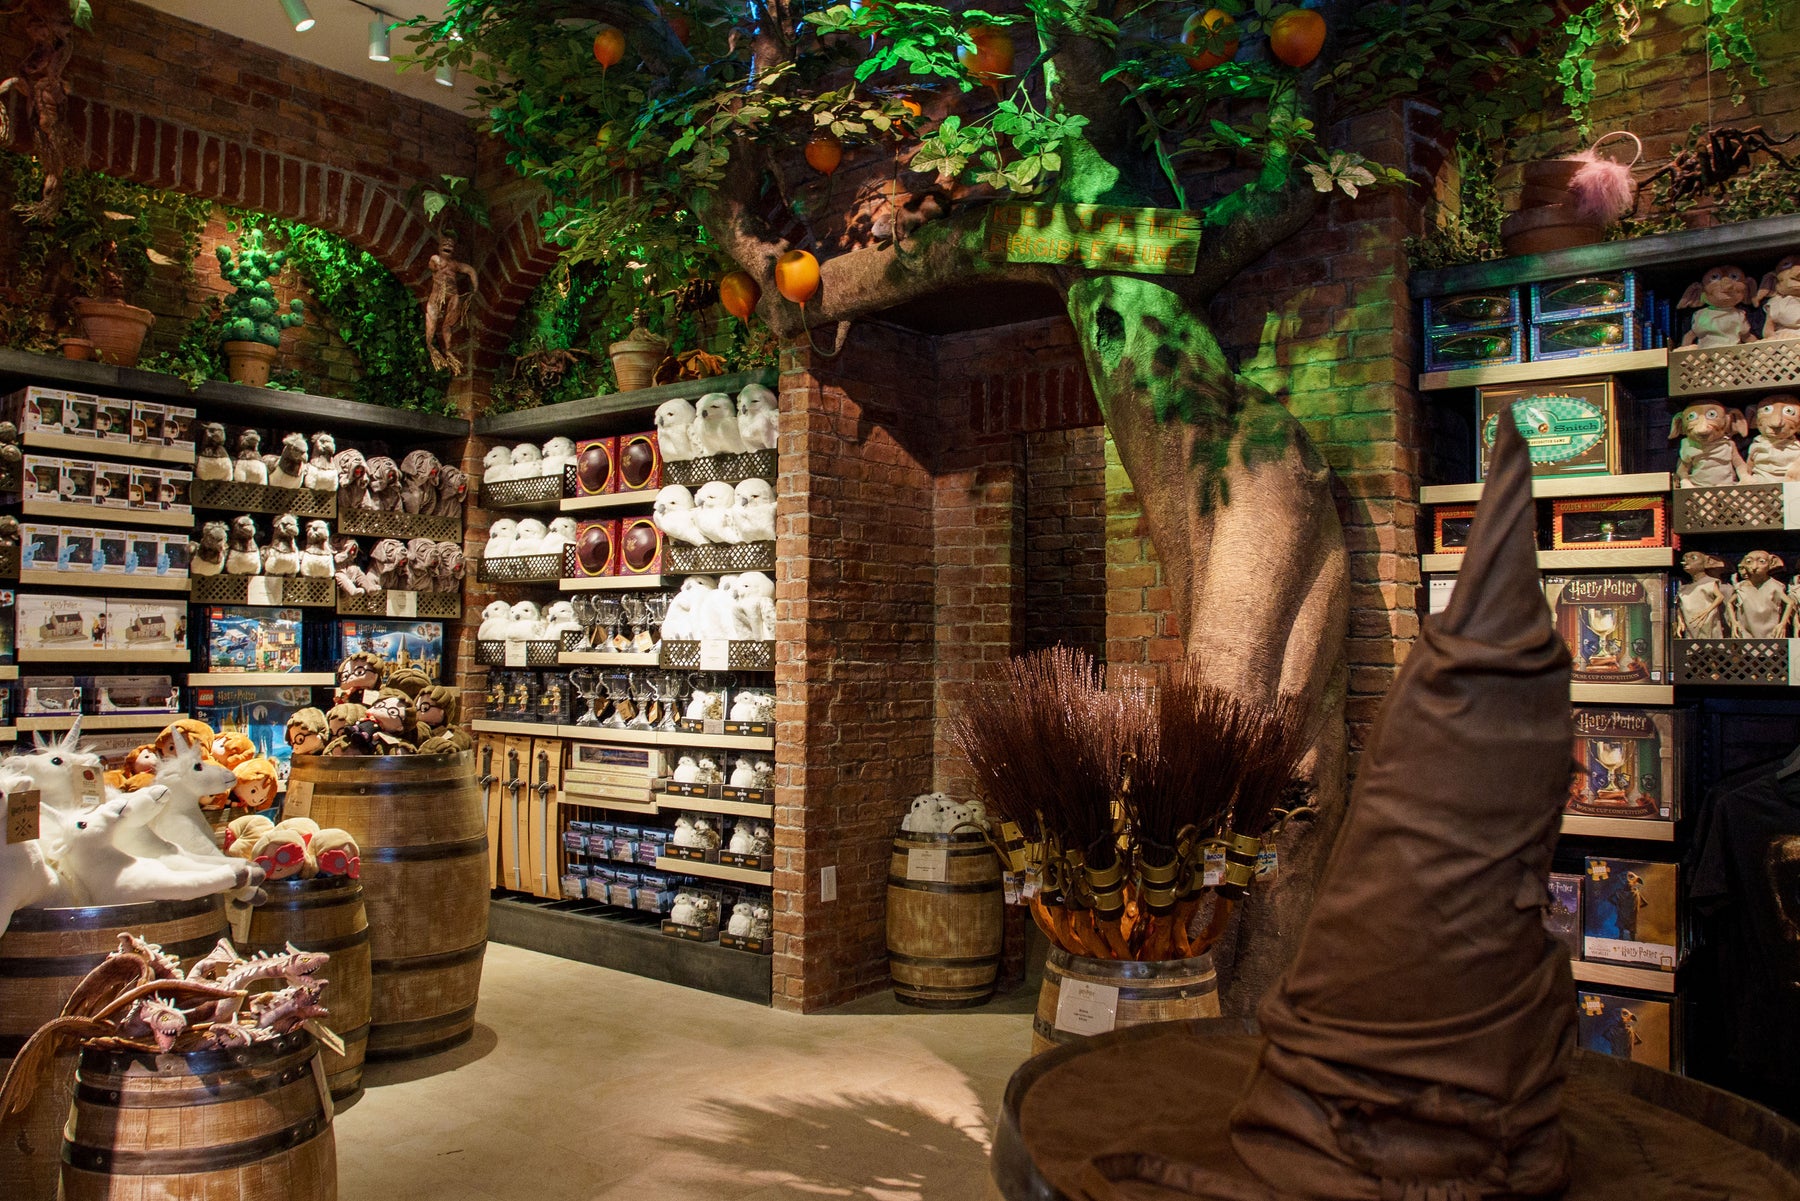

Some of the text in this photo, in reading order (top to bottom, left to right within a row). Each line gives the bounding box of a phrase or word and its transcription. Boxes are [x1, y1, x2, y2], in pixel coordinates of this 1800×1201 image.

[992, 206, 1190, 239] KEEP OFF THE
[990, 233, 1185, 269] DIRIGIBLE PLUMS
[1553, 422, 1598, 433] Snitch
[1569, 578, 1638, 601] Harry Potter
[1578, 711, 1647, 733] Harry Potter
[1638, 946, 1658, 959] Potter
